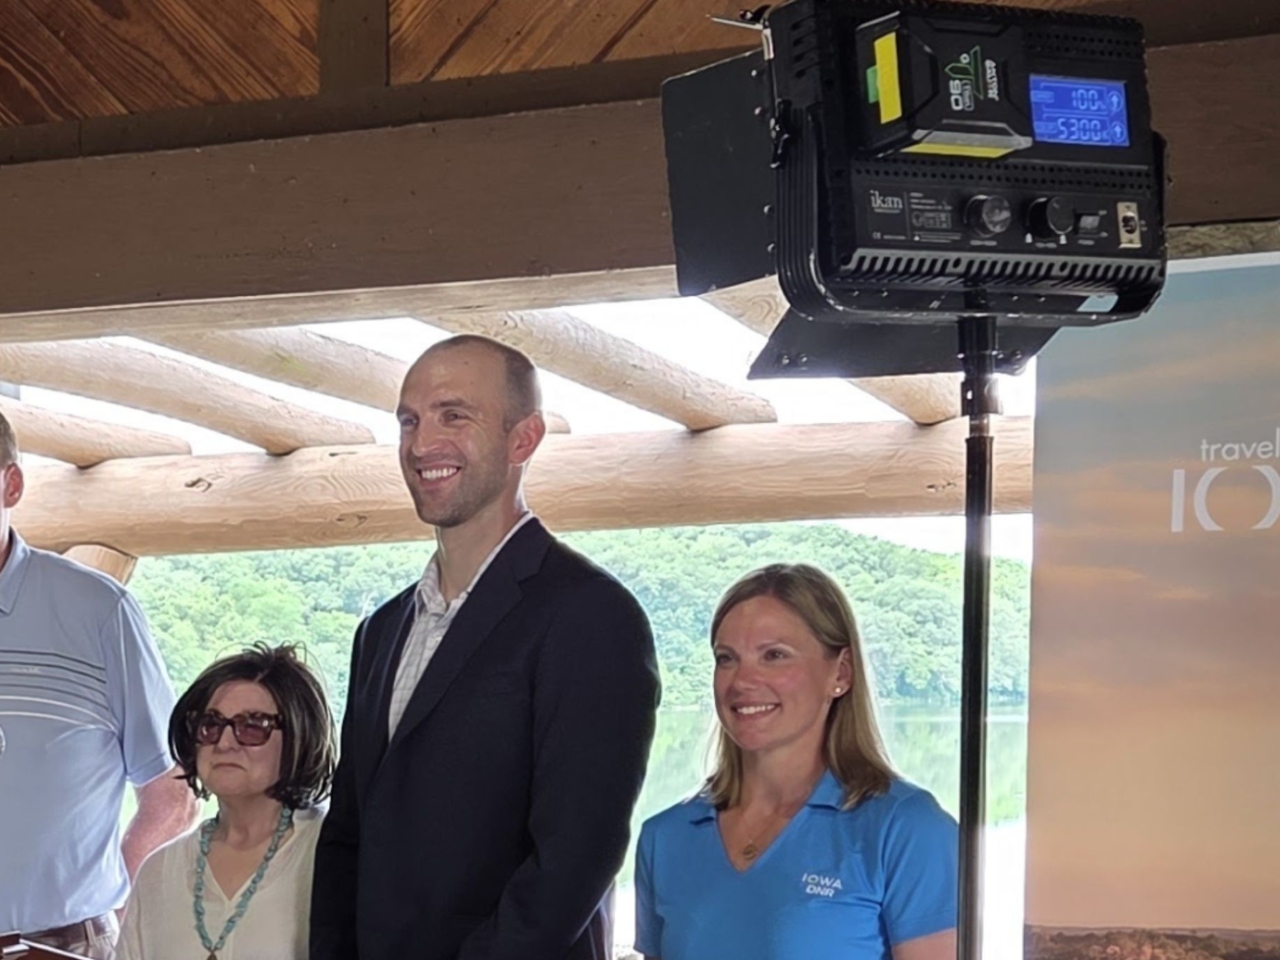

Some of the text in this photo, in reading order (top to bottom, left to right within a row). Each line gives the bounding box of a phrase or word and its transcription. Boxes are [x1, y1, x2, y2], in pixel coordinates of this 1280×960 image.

[870, 190, 903, 209] ikan
[1200, 427, 1280, 462] travel
[802, 873, 843, 890] IOWA
[805, 884, 835, 898] DNR
